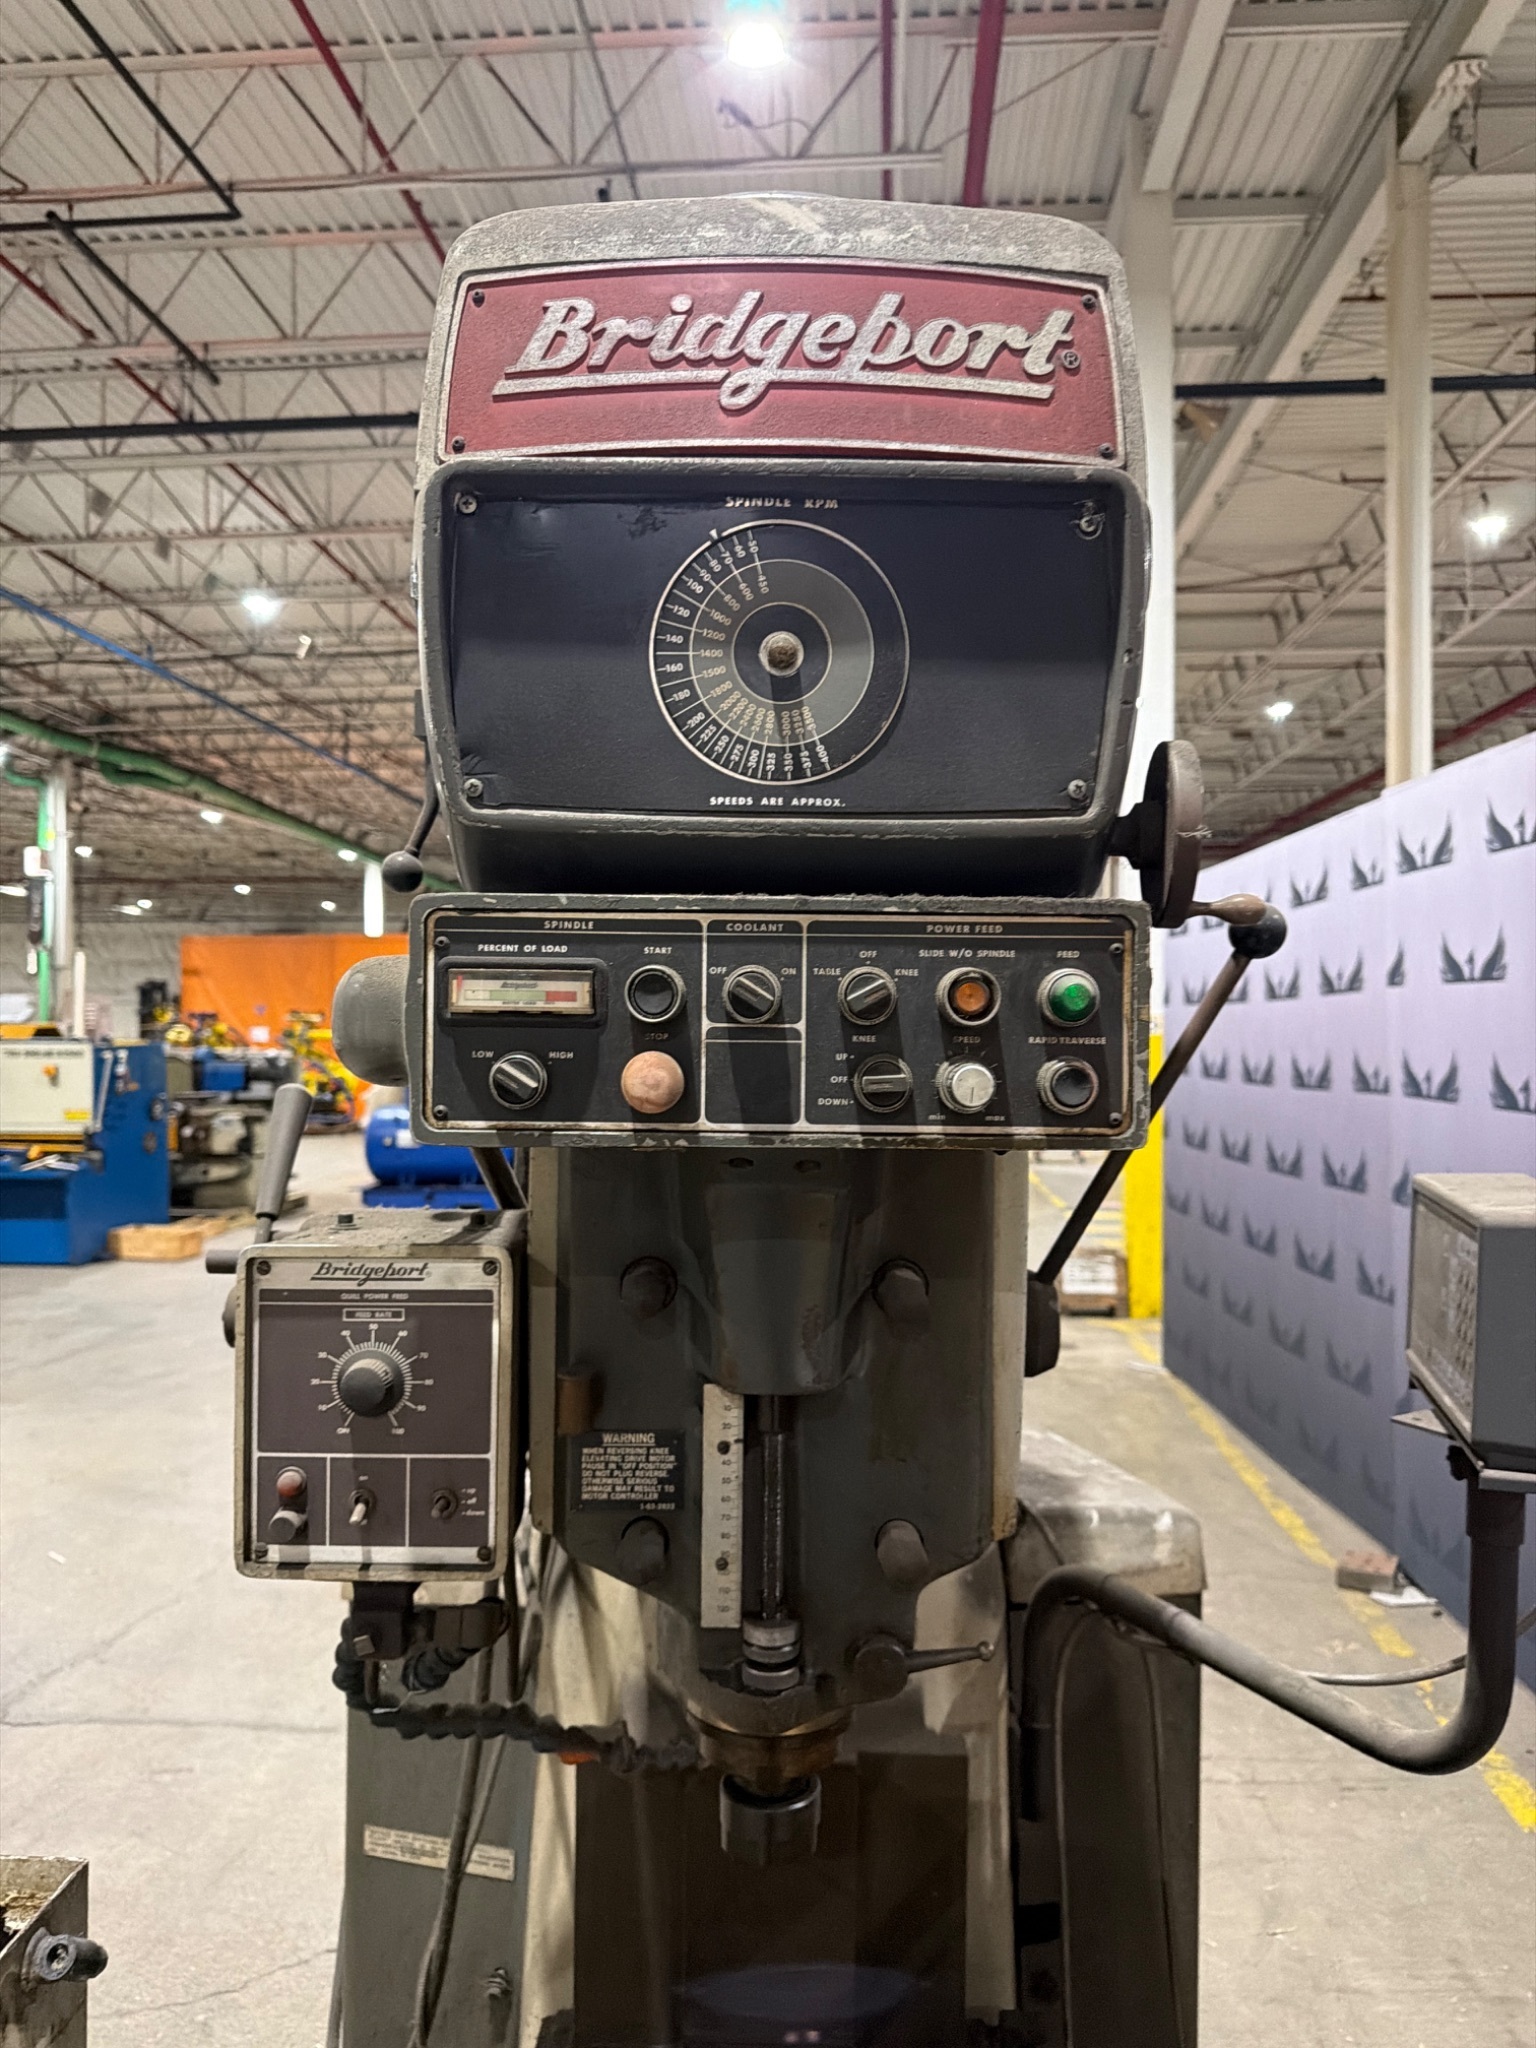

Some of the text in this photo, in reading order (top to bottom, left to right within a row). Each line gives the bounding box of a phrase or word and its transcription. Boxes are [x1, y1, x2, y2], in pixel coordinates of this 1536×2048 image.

[503, 289, 1075, 410] Bridgeport
[725, 497, 792, 508] SPINDLE
[733, 545, 747, 558] 60
[747, 540, 759, 553] 50
[721, 551, 733, 565] 70
[709, 559, 722, 572] 80
[699, 569, 711, 581] 90
[686, 578, 704, 594] 100
[757, 574, 770, 594] 450
[738, 582, 755, 601] 600
[723, 593, 741, 611] 800
[672, 604, 691, 618] 120
[709, 608, 732, 626] 1000
[665, 634, 684, 644] 140
[702, 628, 726, 641] 1200
[700, 649, 724, 658] 1400
[665, 662, 684, 673] 160
[672, 689, 691, 701] 180
[686, 711, 706, 728] 200
[764, 709, 776, 735] 2800
[699, 723, 717, 742] 225
[713, 734, 730, 754] 250
[729, 743, 744, 762] 275
[815, 744, 829, 763] 400
[746, 749, 760, 769] 300
[765, 752, 776, 772] 325
[783, 752, 794, 772] 350
[799, 750, 812, 769] 375
[709, 796, 846, 807] SPEEDS ARE APPROX.
[543, 920, 594, 930] SPINDLE
[725, 923, 784, 932] COOLANT
[926, 924, 1004, 933] POWER FEED
[477, 944, 568, 953] PERCENT OF LOAD
[643, 946, 672, 954] START
[918, 949, 1016, 958] SLIDE W/O SPINDLE
[859, 950, 878, 959] OFF
[1056, 950, 1080, 959] FEED
[708, 966, 727, 975] OFF
[781, 967, 797, 975] ON
[894, 968, 919, 976] KNEE
[644, 1032, 669, 1041] STOP
[852, 1034, 877, 1043] KNEE
[1028, 1036, 1107, 1045] RAPID TRAVERSE
[471, 1050, 495, 1059] LOW
[548, 1051, 574, 1059] HIGH
[835, 1053, 849, 1061] UP
[830, 1075, 849, 1084] OFF
[817, 1098, 849, 1106] DOWN
[311, 1262, 430, 1287] Bridgeport
[602, 1432, 656, 1443] WARNING
